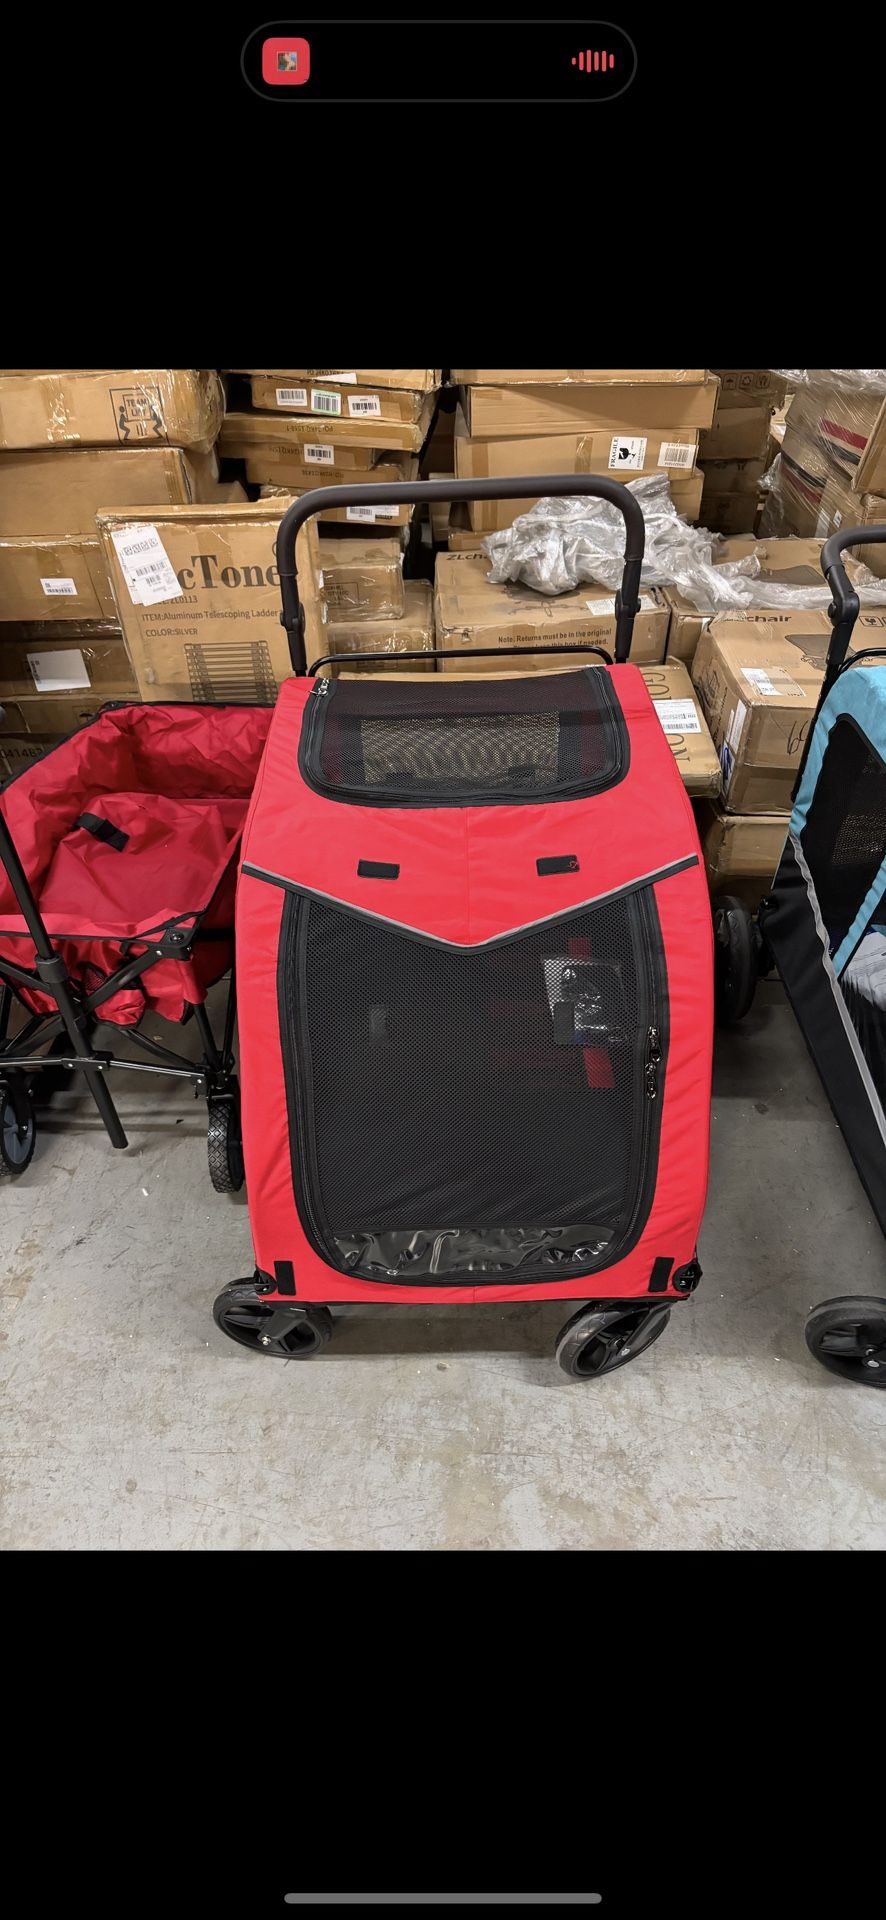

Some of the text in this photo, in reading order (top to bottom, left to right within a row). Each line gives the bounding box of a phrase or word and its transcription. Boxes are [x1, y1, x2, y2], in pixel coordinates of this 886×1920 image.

[609, 438, 619, 467] FRAGILE
[204, 610, 251, 620] Telescoping
[146, 628, 198, 637] COLOR:SILVER
[516, 634, 541, 642] Returns
[586, 629, 612, 637] original
